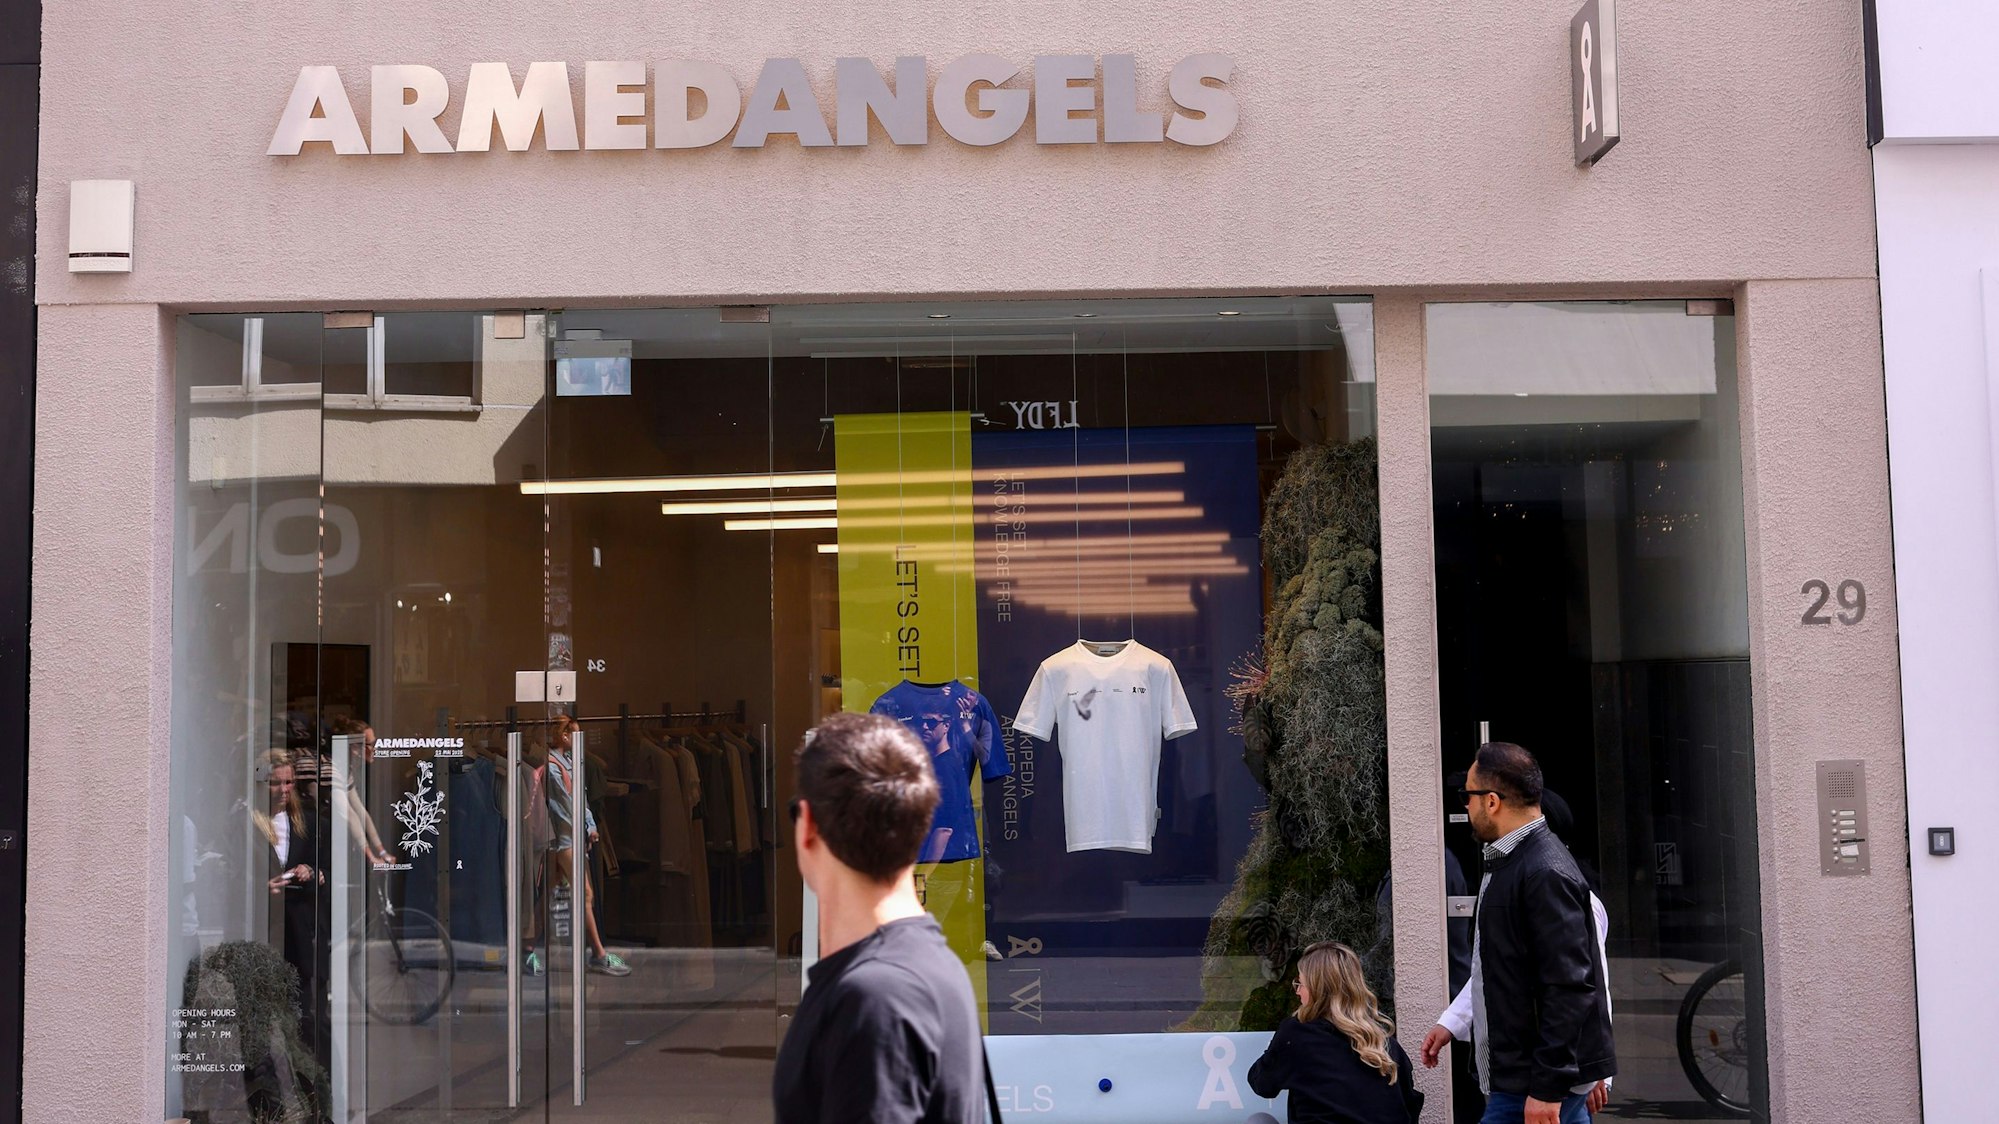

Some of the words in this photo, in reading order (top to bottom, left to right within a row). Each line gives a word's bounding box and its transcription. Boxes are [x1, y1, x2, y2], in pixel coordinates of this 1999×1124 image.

[267, 52, 1240, 157] ARMEDANGELS
[1011, 472, 1026, 516] LET'S
[993, 473, 1010, 577] KNOWLEDGE
[1012, 520, 1027, 551] SET
[996, 581, 1012, 623] FREE
[1801, 579, 1867, 626] 29
[897, 626, 921, 678] SET
[374, 737, 465, 748] ARMEDANGELS
[1019, 729, 1036, 800] KIPEDIA
[172, 1009, 207, 1017] OPENING
[211, 1009, 236, 1017] HOURS
[172, 1020, 187, 1028] MON
[201, 1020, 216, 1028] SAT
[172, 1031, 182, 1039] 10
[186, 1031, 197, 1039] AM
[211, 1031, 216, 1039] 7
[220, 1031, 231, 1039] PM
[171, 1053, 191, 1061] MORE
[195, 1053, 206, 1061] AT
[171, 1064, 245, 1072] ARMEDANGELS.COM
